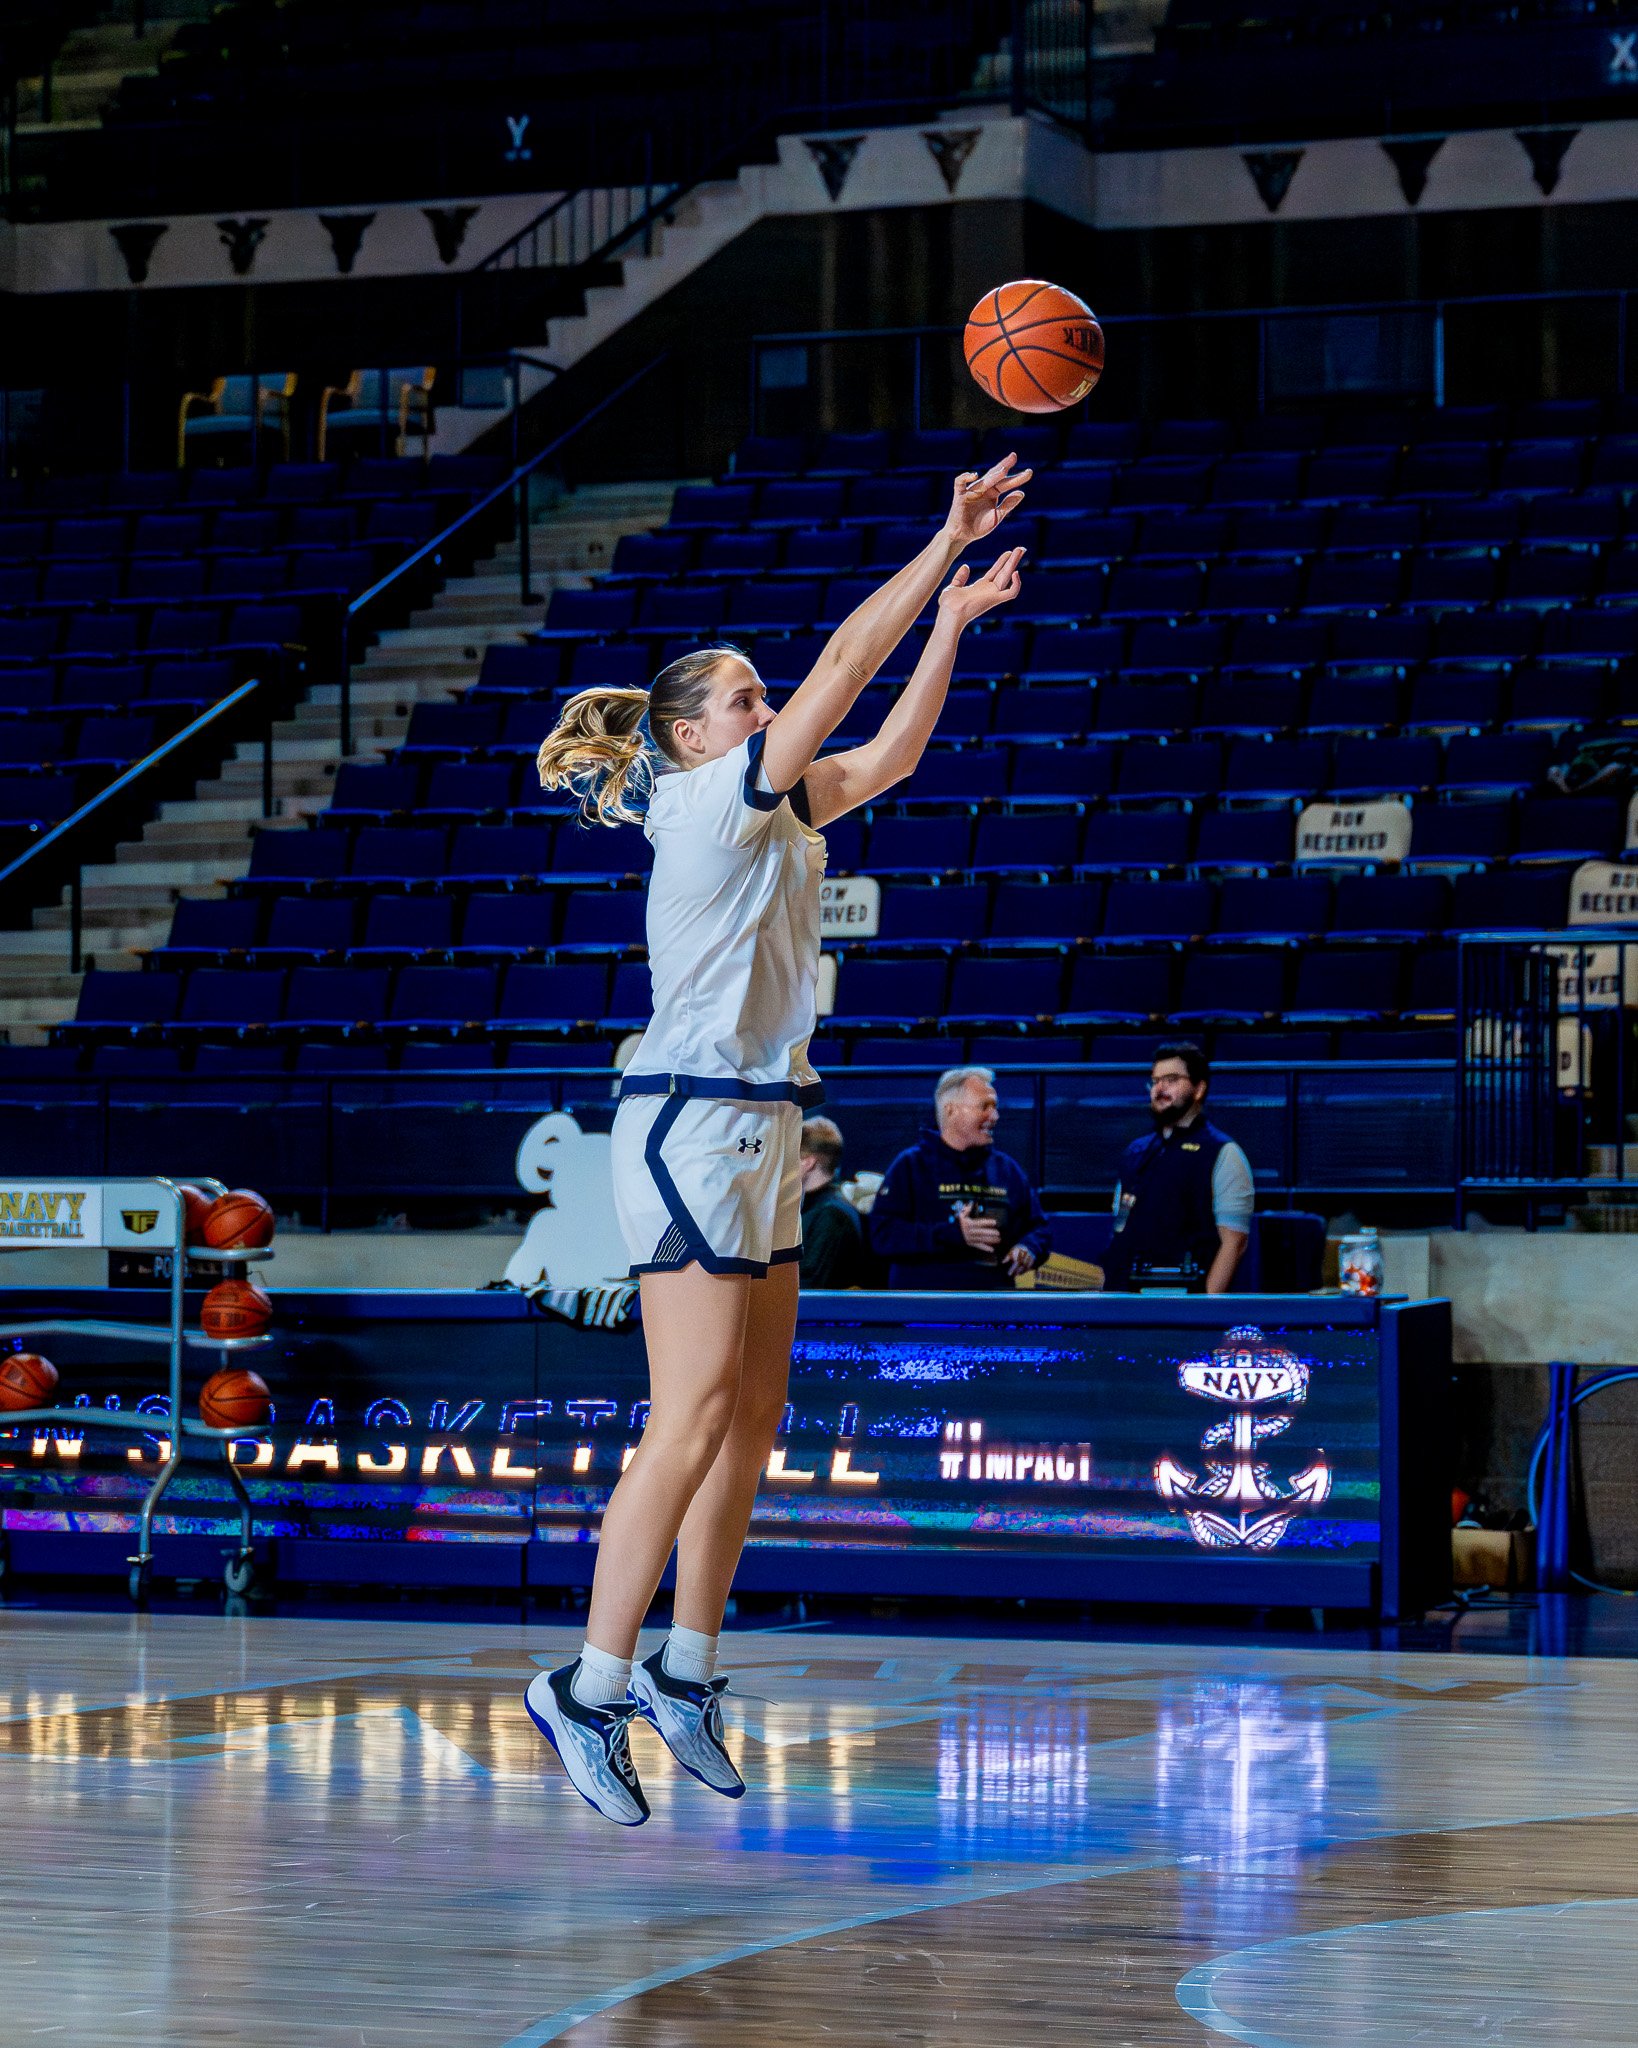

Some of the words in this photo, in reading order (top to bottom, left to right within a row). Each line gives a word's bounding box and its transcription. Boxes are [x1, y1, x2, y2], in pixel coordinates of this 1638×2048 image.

[1611, 32, 1637, 70] X
[507, 115, 529, 147] Y
[822, 886, 848, 900] OW
[0, 1192, 87, 1220] NAVY
[1203, 1372, 1285, 1397] NAVY
